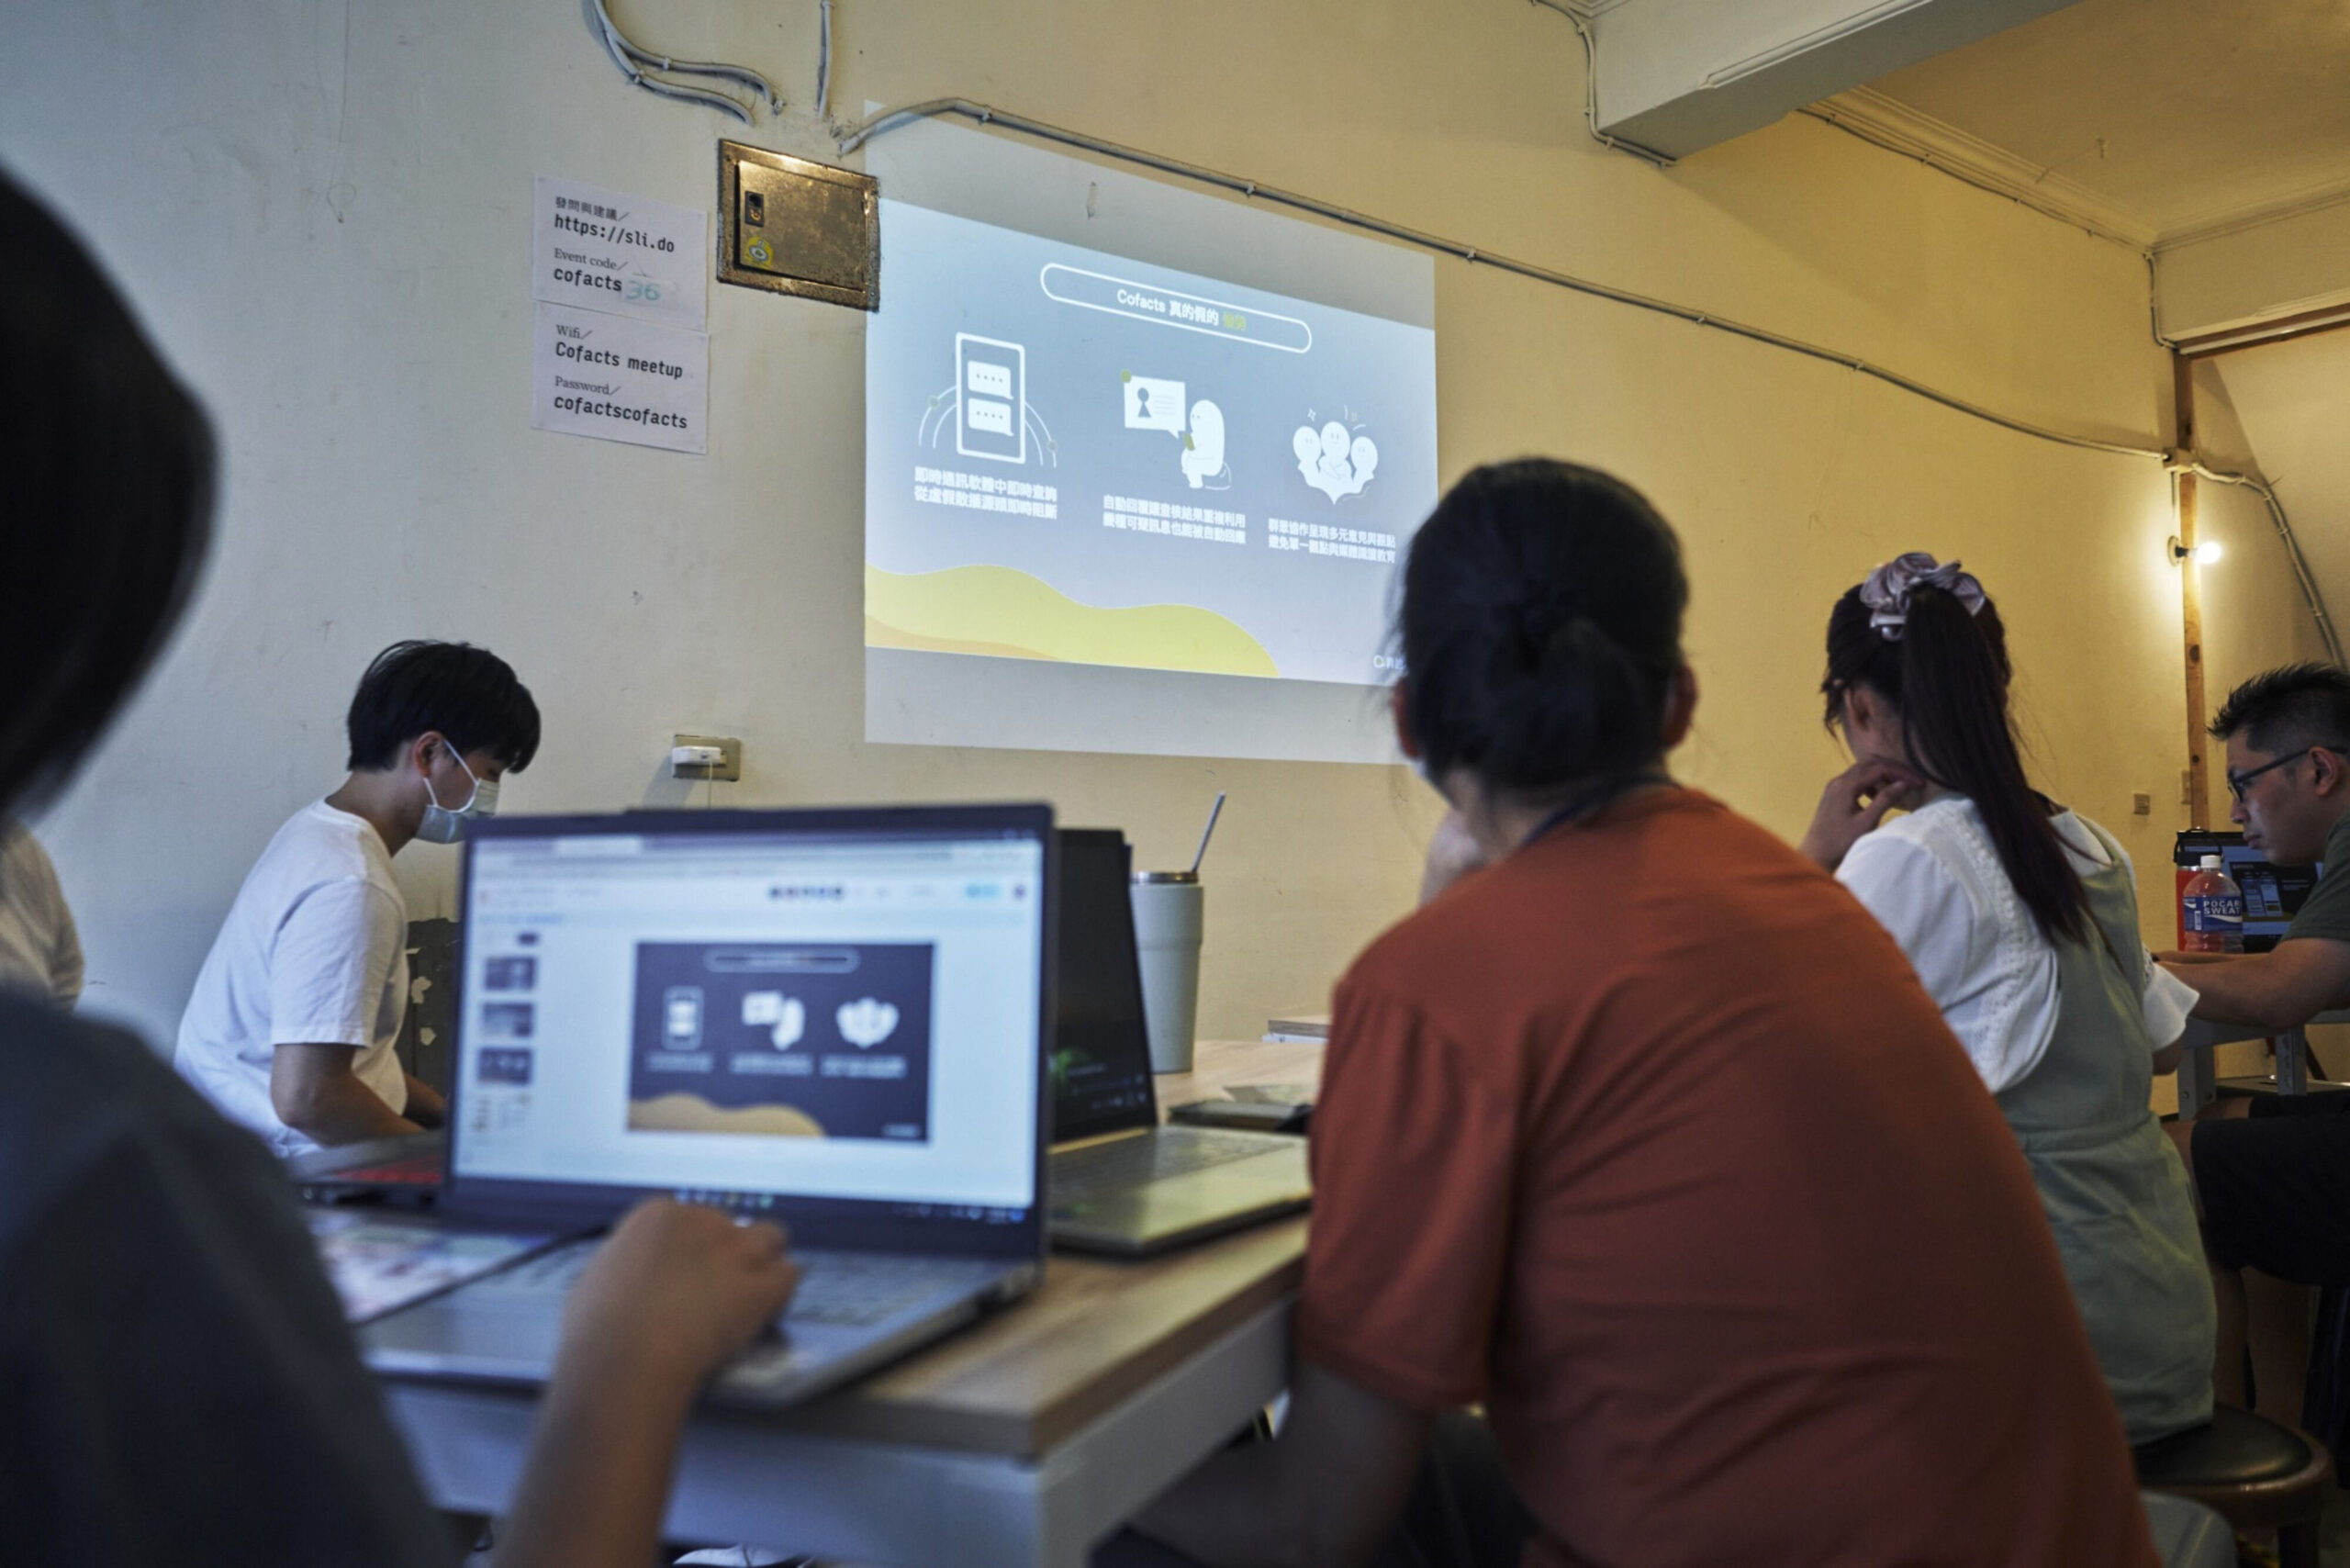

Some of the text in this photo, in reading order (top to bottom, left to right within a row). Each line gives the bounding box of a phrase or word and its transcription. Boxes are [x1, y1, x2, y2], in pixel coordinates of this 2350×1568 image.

[554, 213, 676, 253] https://sli.do
[554, 247, 588, 264] Event
[553, 267, 662, 301] cofacts 36
[1116, 287, 1167, 314] Cofacts
[554, 341, 684, 380] Cofacts meetup
[554, 396, 688, 430] cofactscofacts
[2203, 907, 2241, 915] SWEAT
